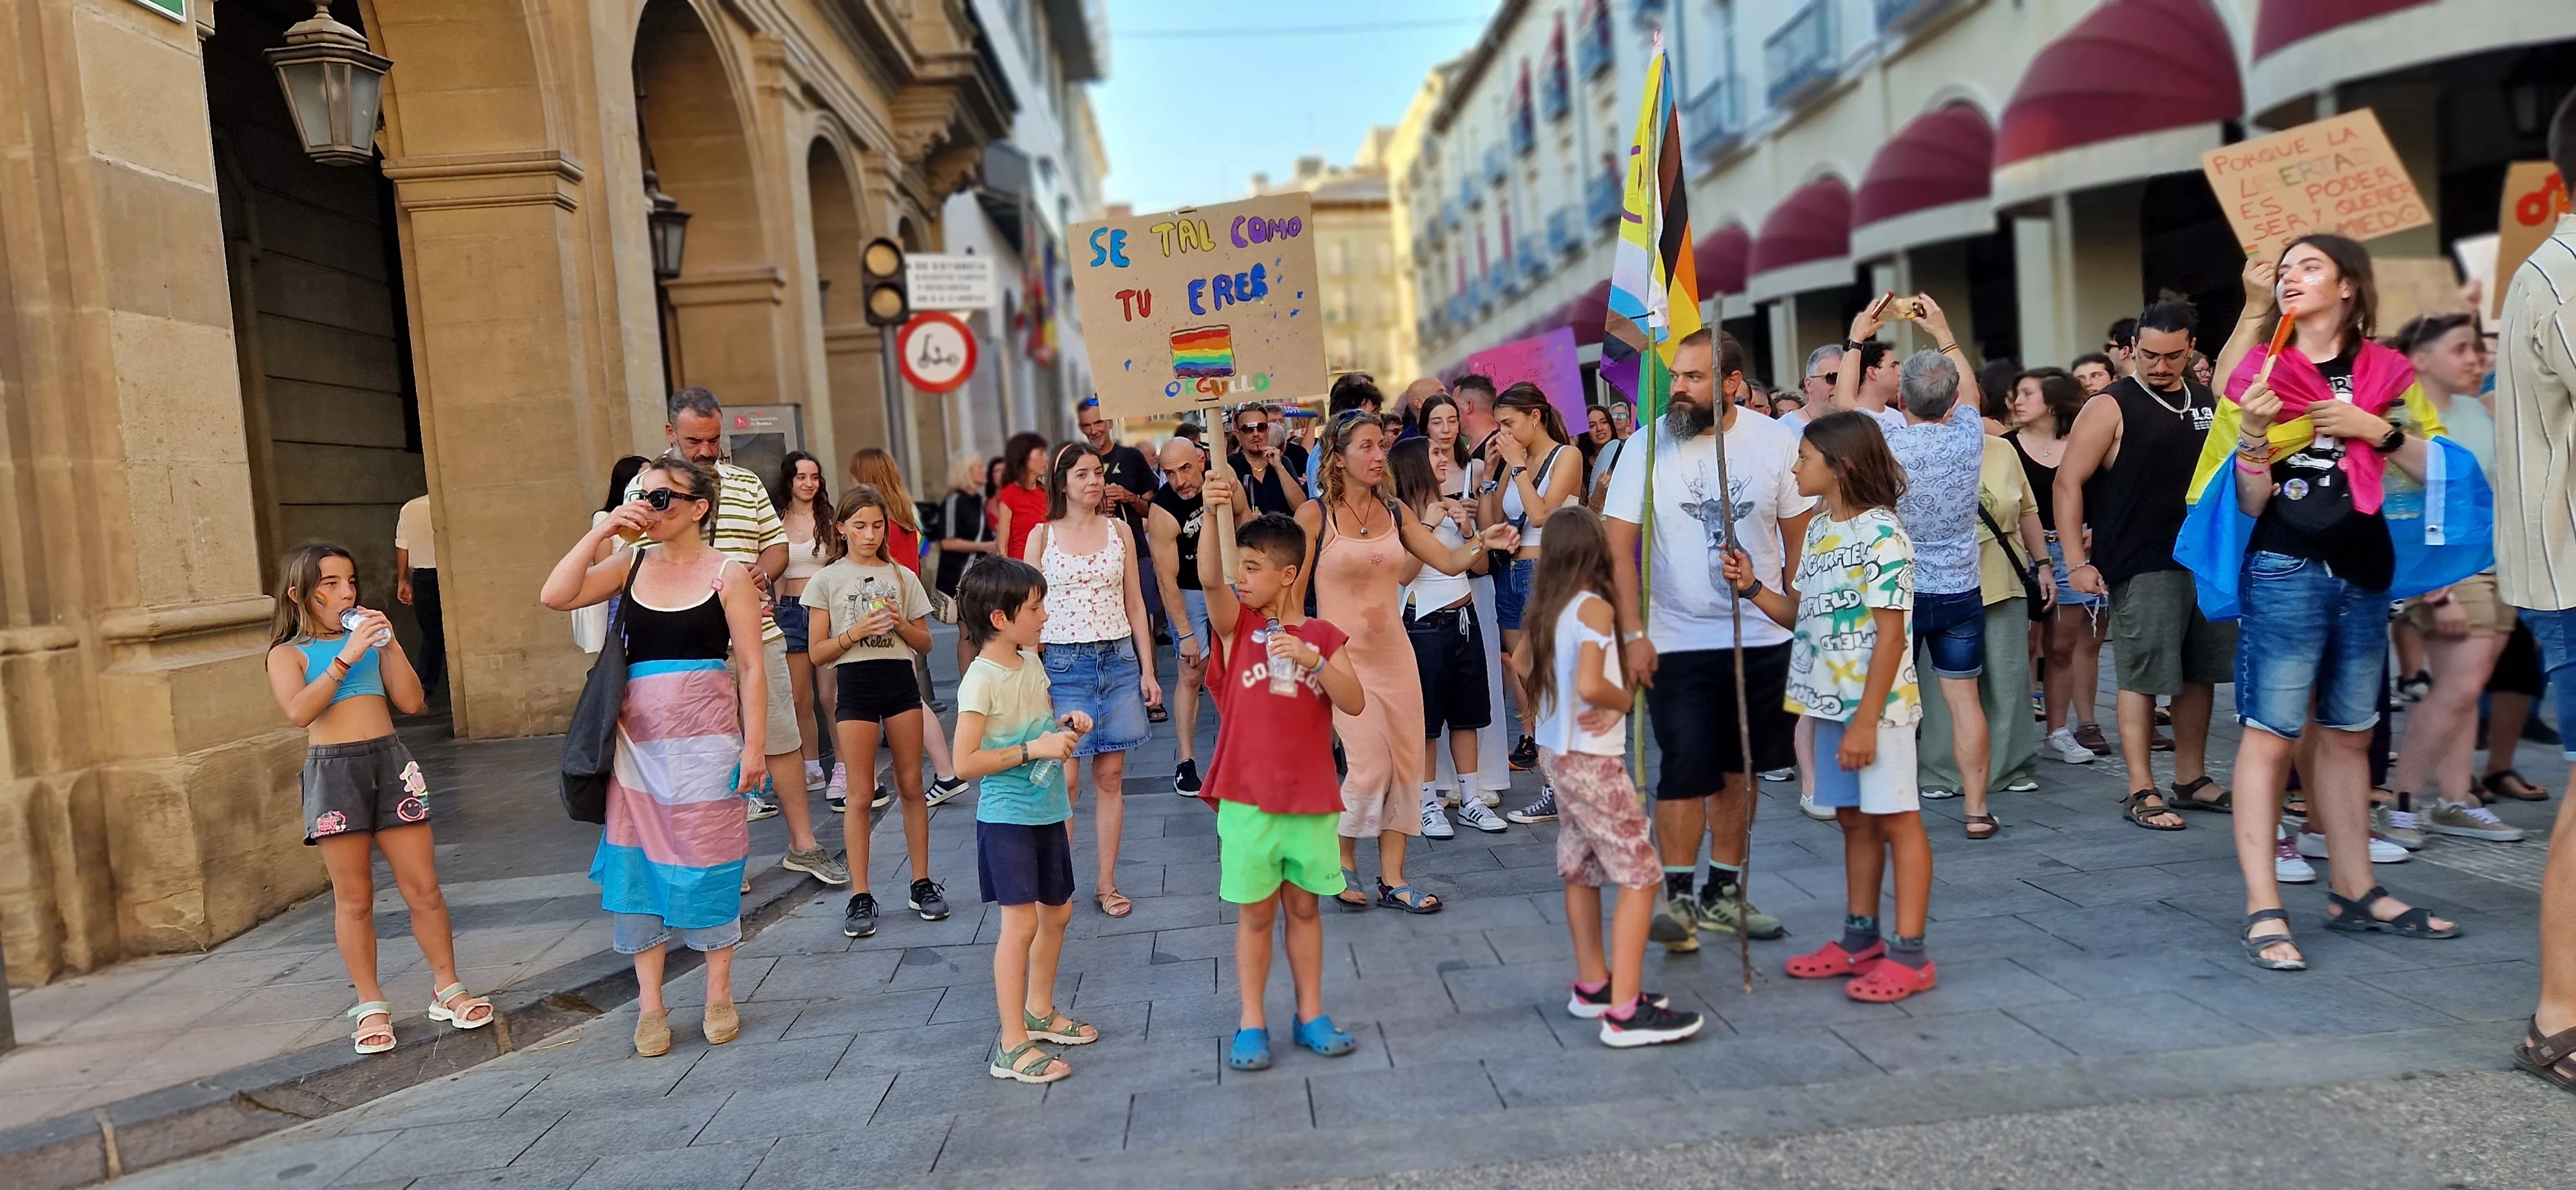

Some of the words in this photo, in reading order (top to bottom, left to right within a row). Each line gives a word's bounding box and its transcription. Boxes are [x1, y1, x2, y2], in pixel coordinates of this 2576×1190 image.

[2212, 137, 2311, 175] PORQUE
[2327, 128, 2359, 146] LA
[2240, 196, 2282, 220] ES
[2305, 167, 2398, 203] PODER
[2253, 214, 2309, 241] SER
[2336, 203, 2422, 236] MIEDO
[1089, 227, 1130, 268] SE
[1150, 218, 1216, 258] TAL
[1231, 215, 1302, 249] COMO
[1115, 288, 1151, 321] TU
[1164, 373, 1271, 397] ORGULLO
[1798, 589, 1862, 622] RFIELD
[860, 635, 895, 648] Relax
